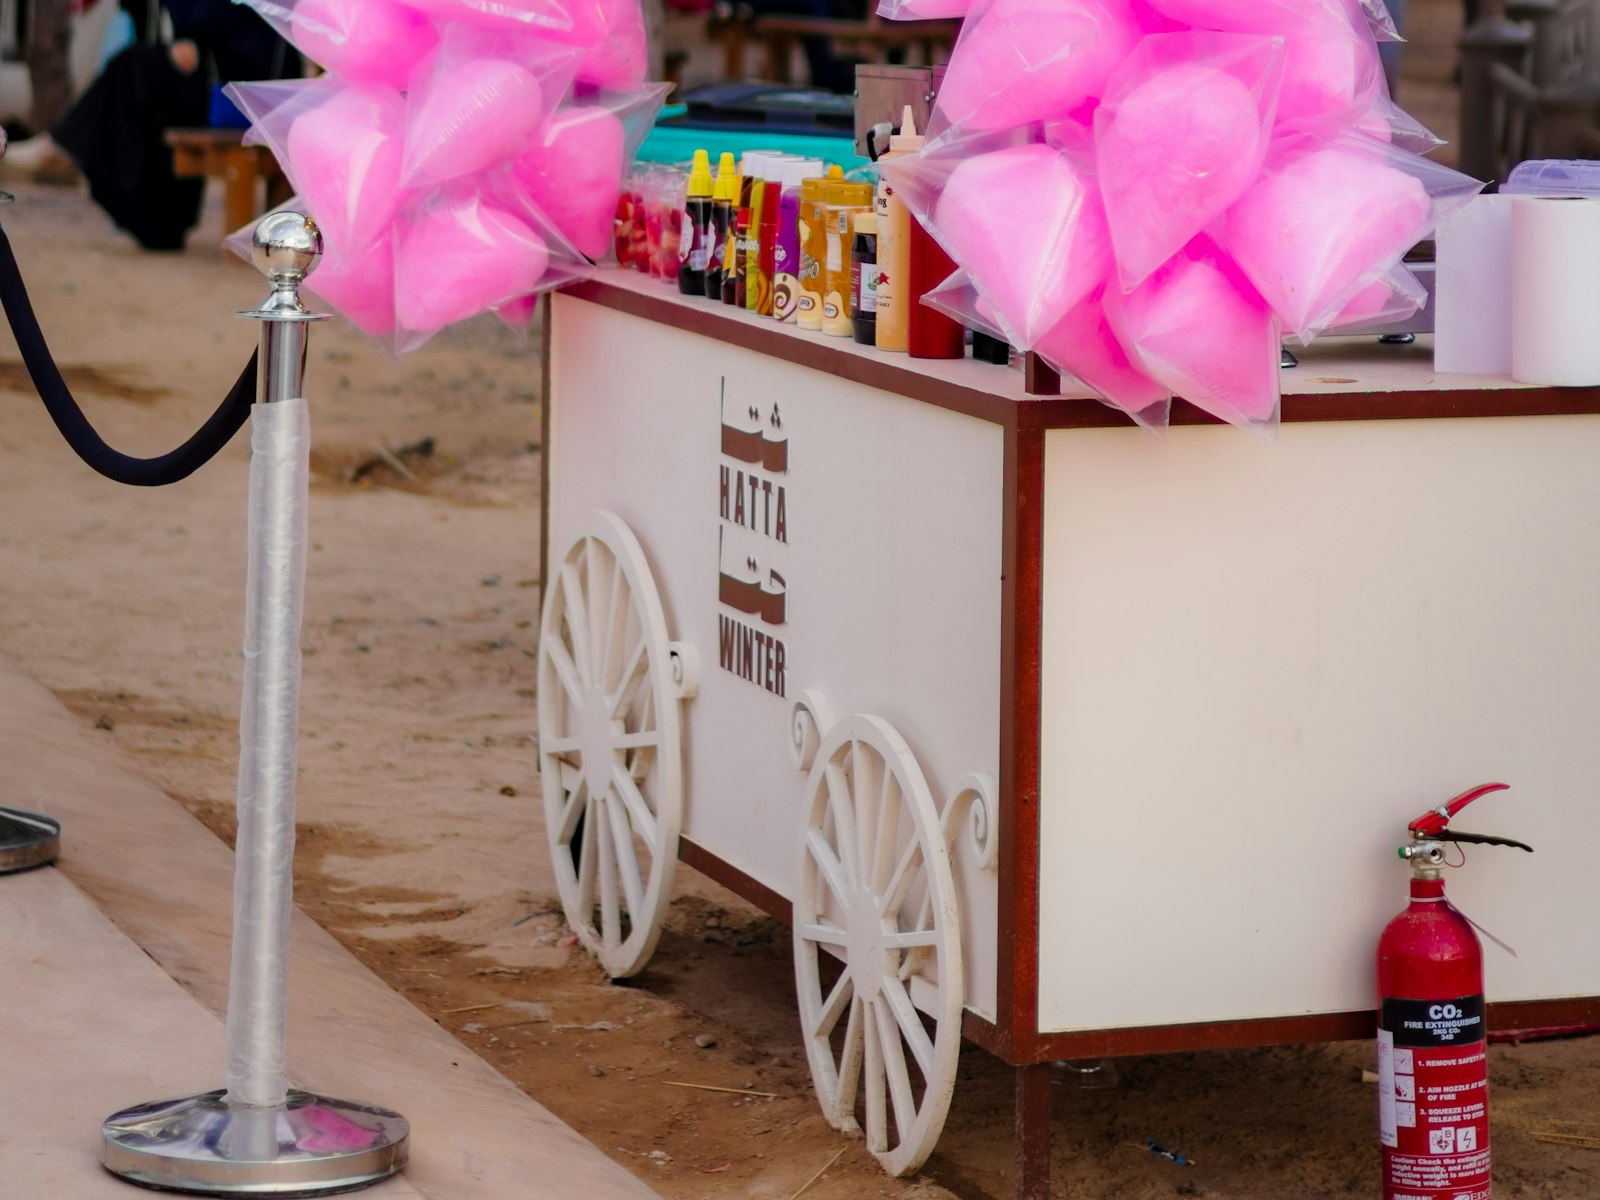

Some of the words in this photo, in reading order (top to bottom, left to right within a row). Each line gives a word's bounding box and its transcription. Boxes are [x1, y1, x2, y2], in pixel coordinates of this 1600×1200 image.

[719, 464, 788, 545] HATTA
[718, 613, 788, 700] WINTER
[1429, 1004, 1462, 1020] CO2
[1404, 1021, 1423, 1029] FIRE
[1425, 1016, 1480, 1029] EXTINGUISHER
[1426, 1059, 1457, 1067] REMOVE
[1458, 1055, 1479, 1065] SAFETY
[1443, 1084, 1470, 1092] NOZZLE
[1428, 1107, 1462, 1115] SQUEEZE
[1429, 1115, 1461, 1123] RELEASE
[1445, 1130, 1452, 1138] B
[1391, 1155, 1416, 1165] Caution:
[1413, 1165, 1446, 1173] annually,
[1422, 1172, 1448, 1180] weight
[1450, 1171, 1457, 1179] is
[1402, 1178, 1421, 1187] filling
